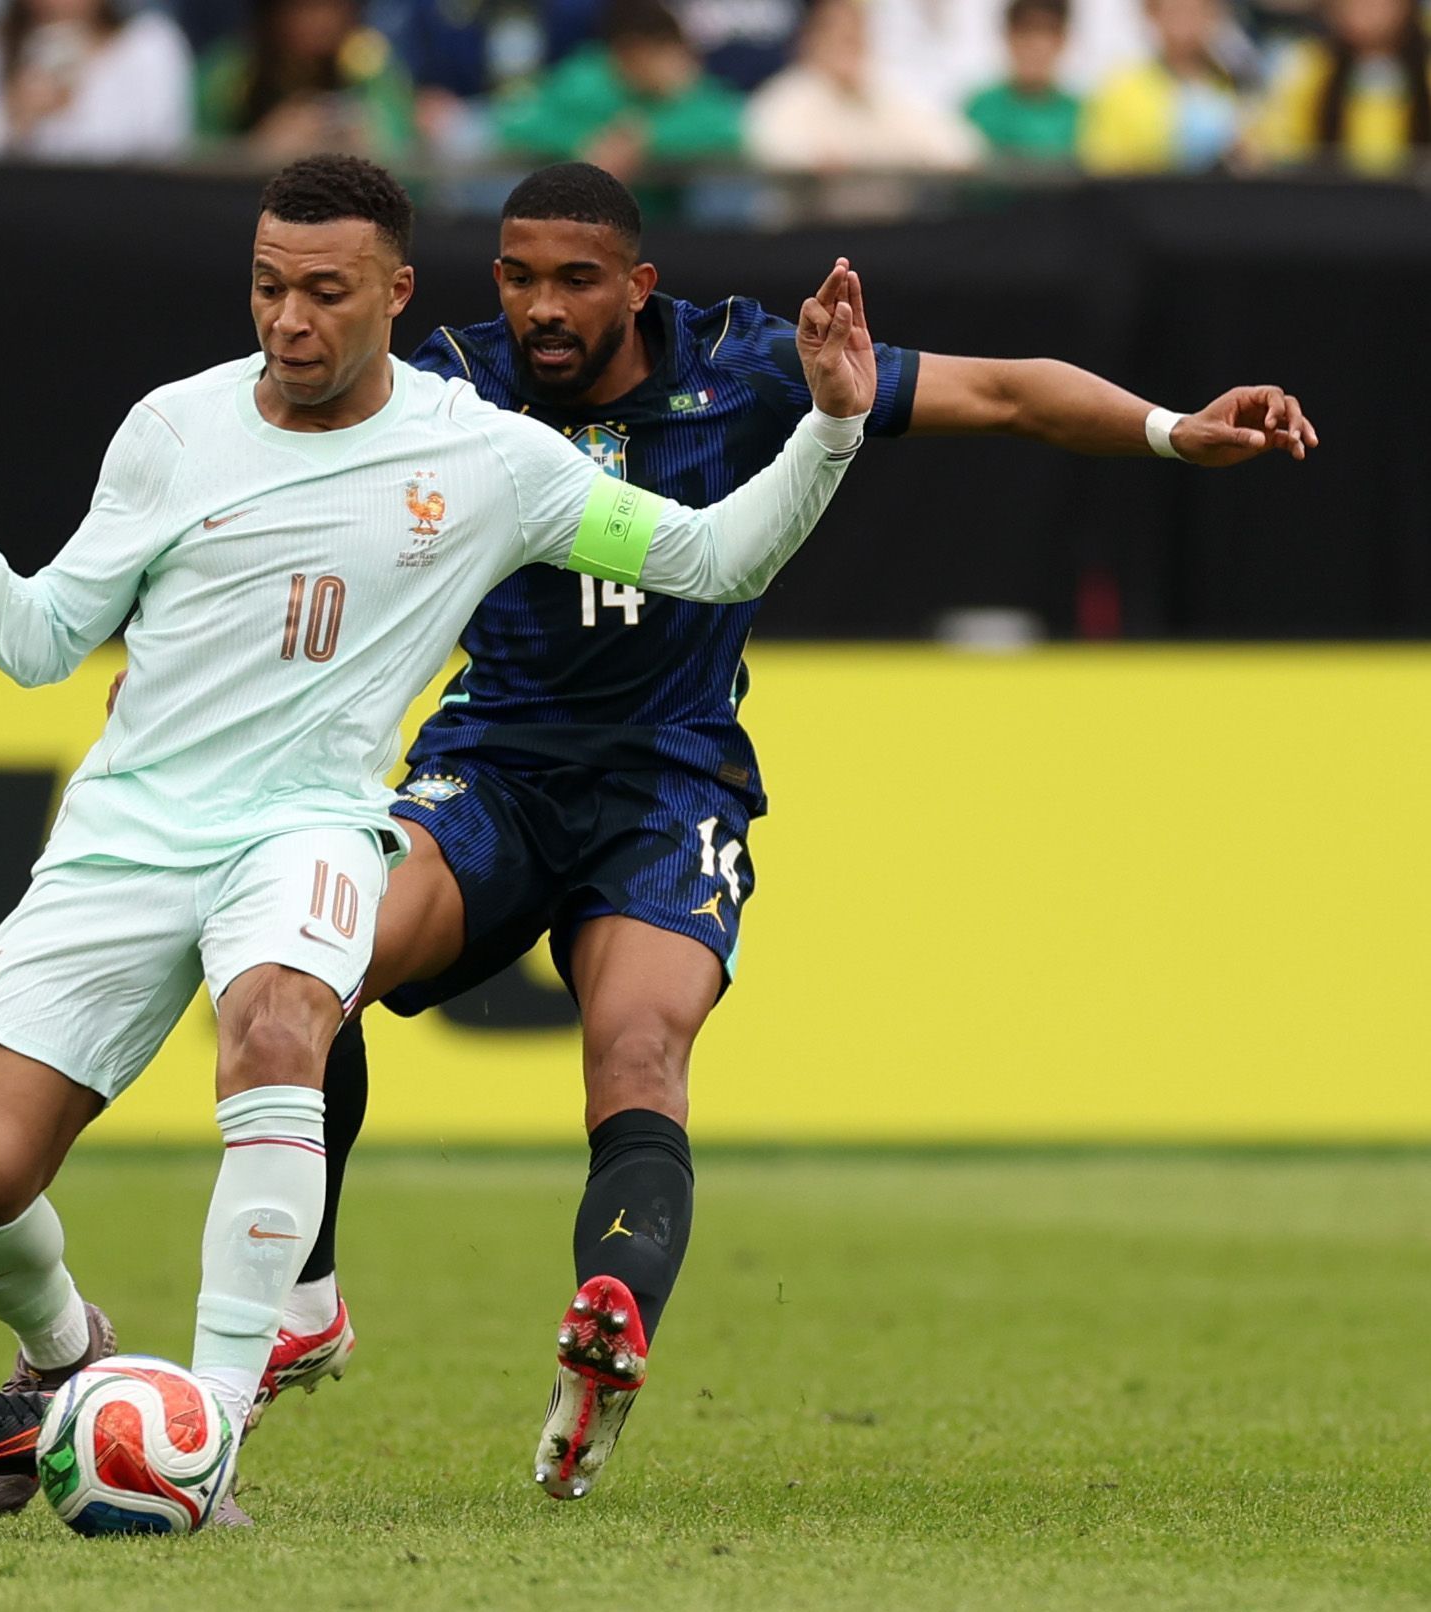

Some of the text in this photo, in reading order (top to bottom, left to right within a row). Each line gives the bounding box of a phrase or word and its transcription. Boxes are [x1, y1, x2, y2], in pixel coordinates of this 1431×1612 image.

[593, 456, 608, 466] BF
[280, 572, 347, 663] 10
[580, 572, 646, 627] 14
[309, 859, 359, 940] 10
[696, 816, 743, 906] 14
